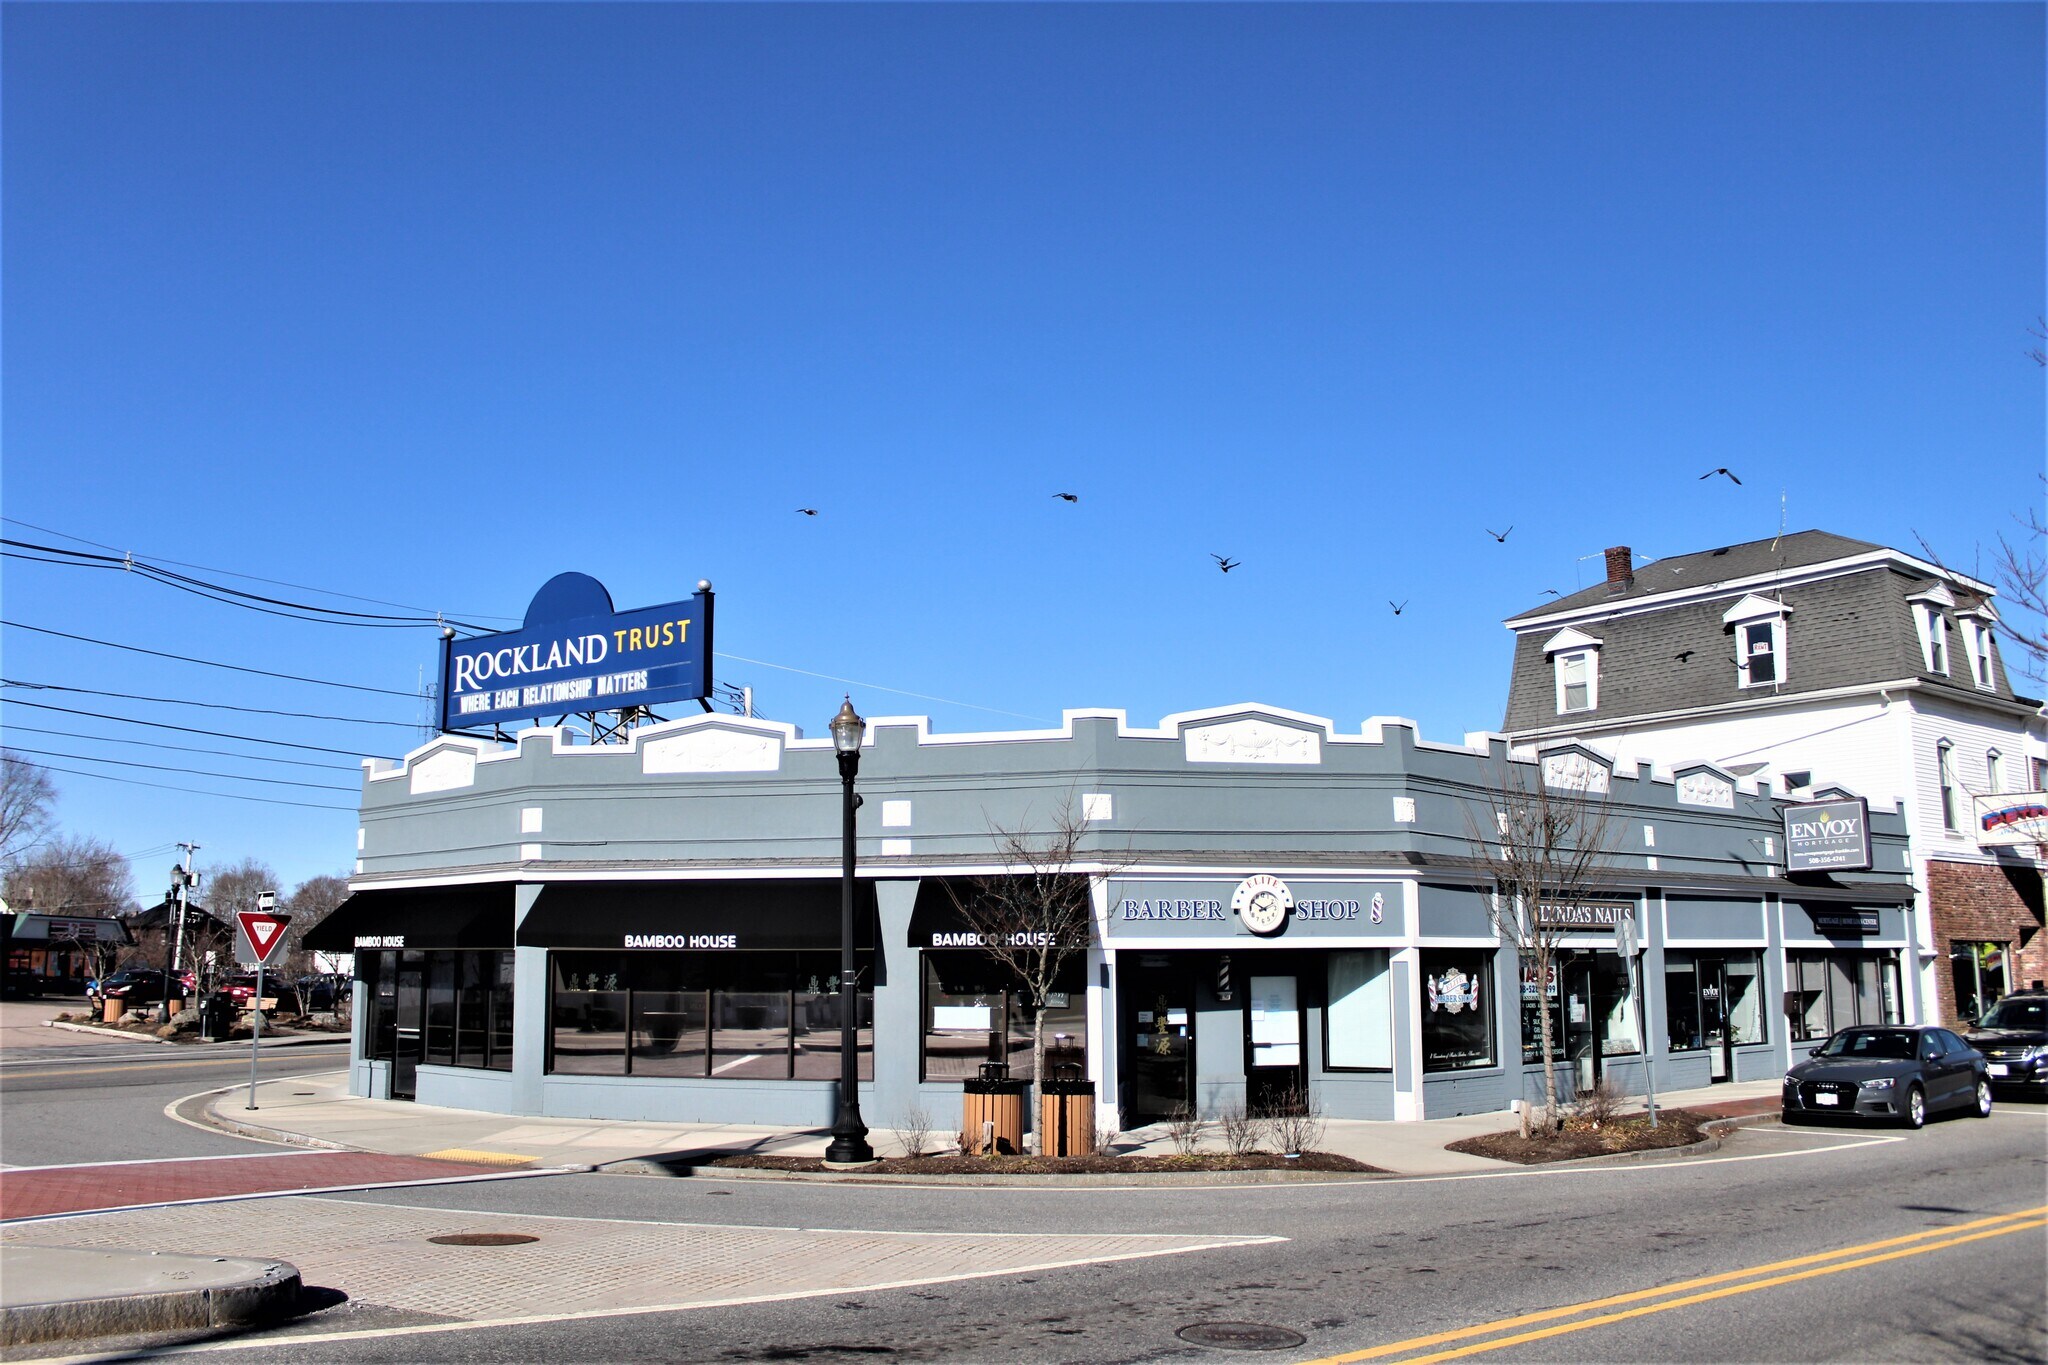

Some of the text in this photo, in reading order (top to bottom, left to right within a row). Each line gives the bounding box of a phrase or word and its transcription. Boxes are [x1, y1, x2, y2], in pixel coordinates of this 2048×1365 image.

[454, 619, 691, 692] ROCKLAND TRUST
[460, 671, 648, 713] WHERE EACH RELATIONSHIP MATTERS
[1790, 819, 1858, 839] ENVOY
[1797, 838, 1849, 846] MORTGAGE
[1246, 876, 1278, 889] ELITE
[1122, 899, 1360, 921] BARBER SHOP
[1540, 905, 1591, 922] LYNDA'S
[354, 936, 405, 947] BAMBOO HOUSE
[624, 934, 737, 948] BAMBOO HOUSE
[932, 932, 1056, 946] BAMBOO HOUSE
